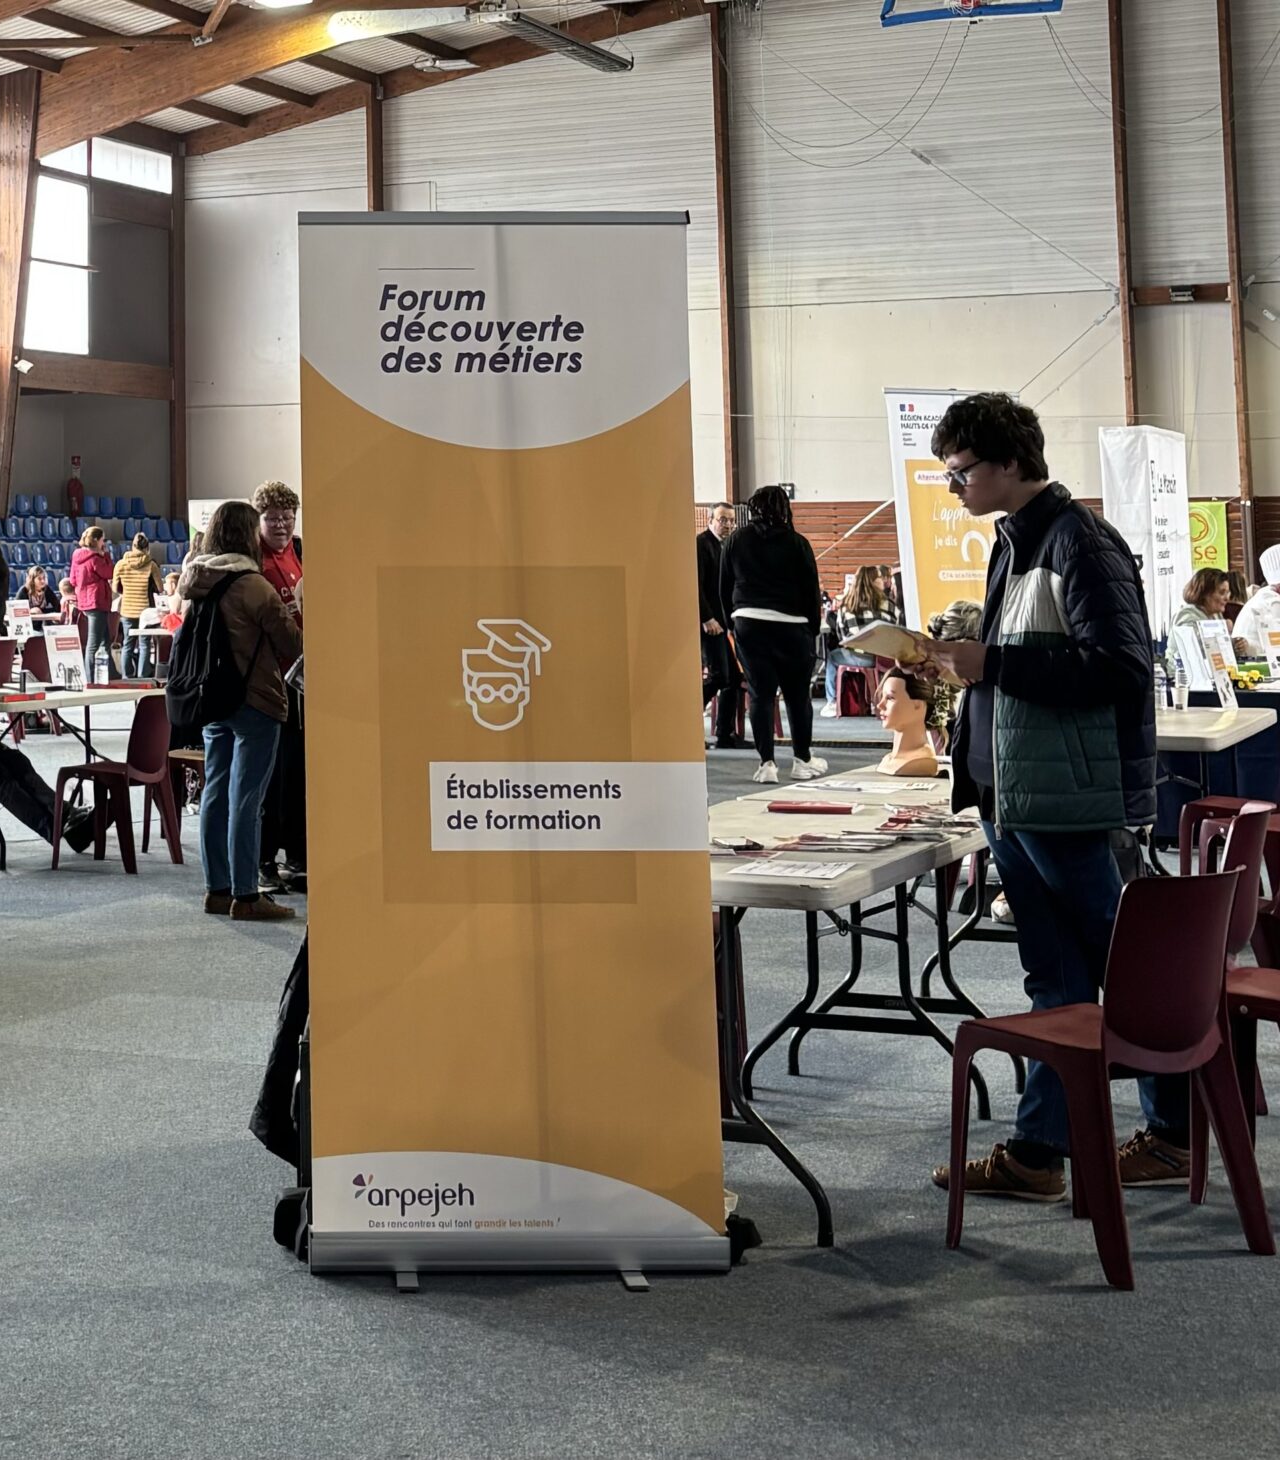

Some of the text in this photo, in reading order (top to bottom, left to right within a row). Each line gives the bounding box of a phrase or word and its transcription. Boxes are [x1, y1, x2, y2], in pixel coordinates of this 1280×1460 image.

[379, 284, 486, 311] Forum
[380, 312, 584, 342] découverte
[381, 342, 583, 373] des métiers
[446, 773, 622, 799] Établissements
[446, 809, 601, 830] de formation
[367, 1182, 476, 1217] arpejeh
[368, 1219, 386, 1229] Des
[387, 1219, 437, 1229] rencontres
[438, 1219, 454, 1230] qui
[454, 1218, 473, 1229] font
[474, 1218, 508, 1230] grandir
[508, 1218, 522, 1229] les
[523, 1218, 555, 1229] talents
